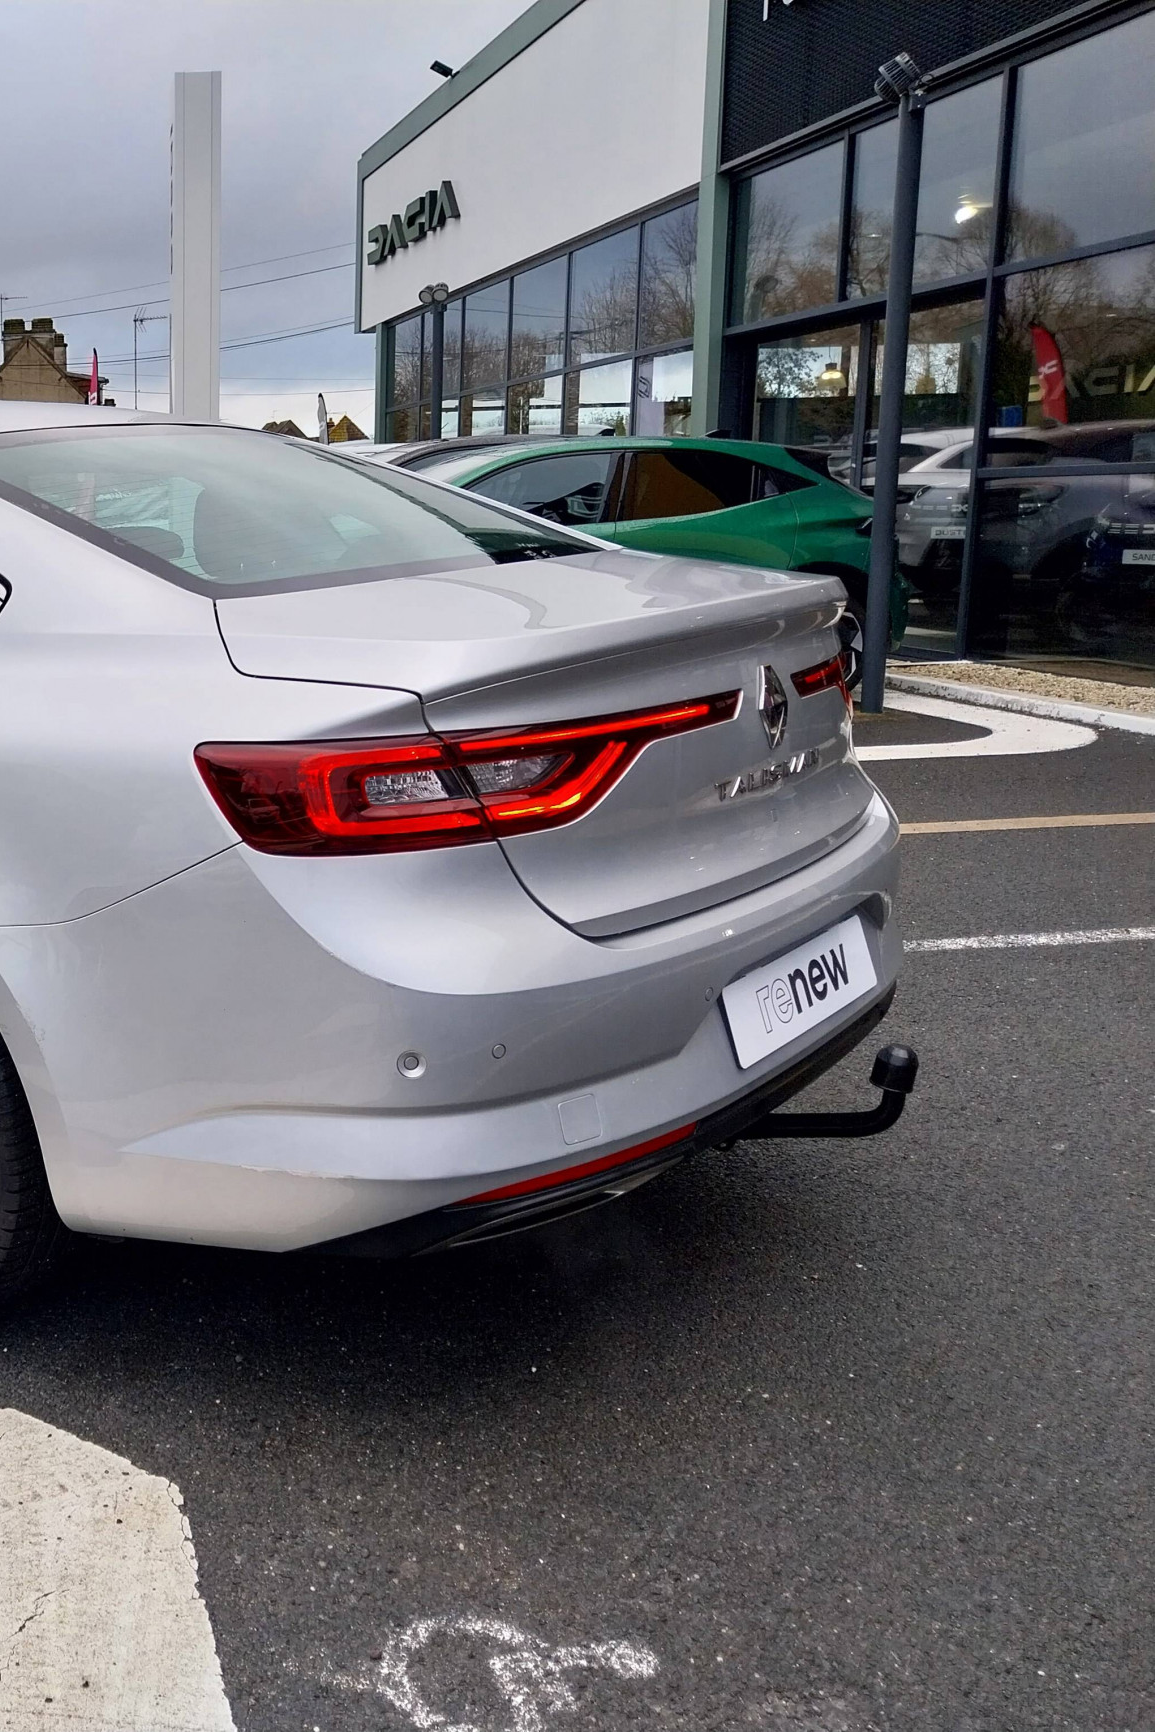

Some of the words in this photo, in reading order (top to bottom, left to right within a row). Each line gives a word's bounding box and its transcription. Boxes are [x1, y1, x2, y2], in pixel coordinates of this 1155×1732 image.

[367, 181, 460, 266] DACIA
[714, 747, 819, 802] TALISMAN
[756, 943, 849, 1033] renew
